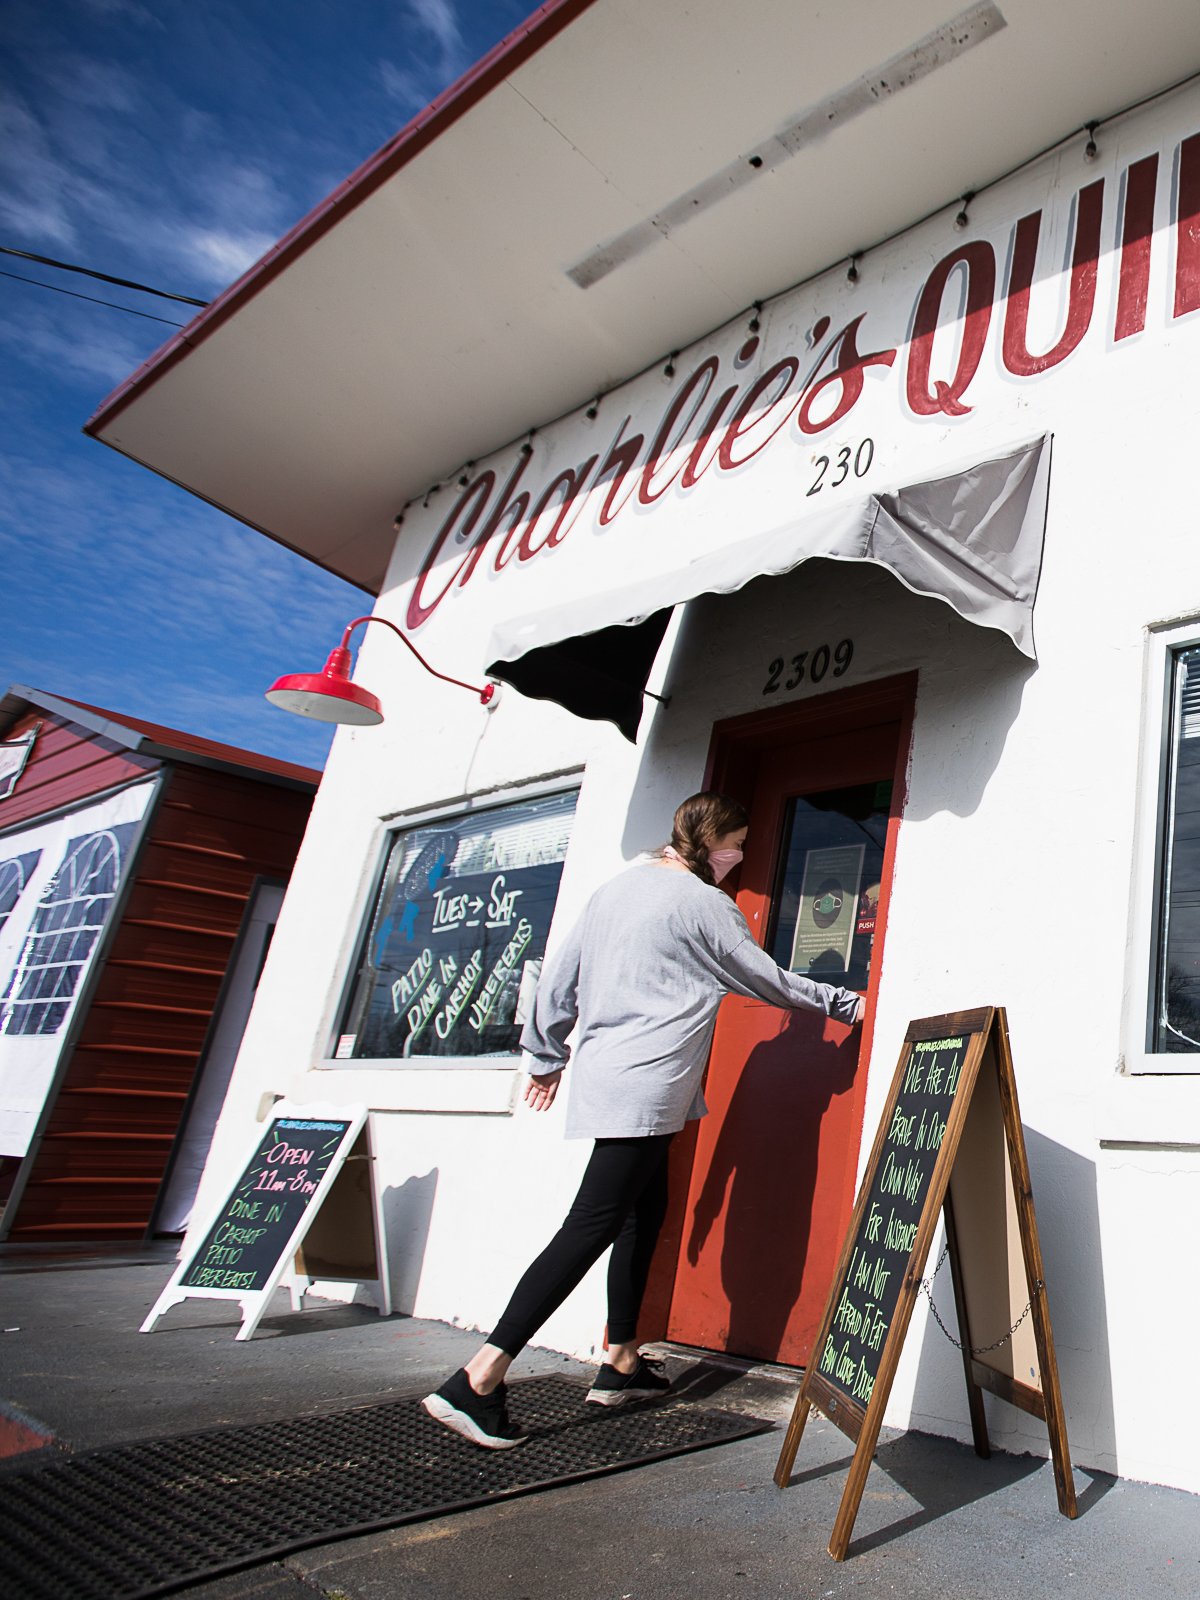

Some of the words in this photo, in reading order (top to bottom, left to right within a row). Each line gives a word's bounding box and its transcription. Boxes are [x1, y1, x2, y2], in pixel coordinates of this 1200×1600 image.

[404, 311, 897, 630] Charlie's
[806, 437, 875, 497] 230
[762, 638, 854, 696] 2309
[858, 921, 875, 929] PUSH
[392, 948, 432, 1014] PATIO
[407, 977, 442, 1034] DINE
[440, 955, 458, 985] IN
[435, 949, 482, 1039] CARHOP
[904, 1052, 925, 1094] WE
[923, 1053, 945, 1094] ARE
[888, 1105, 917, 1147] BRAVE
[914, 1108, 928, 1151] IN
[267, 1142, 315, 1165] OPEN
[228, 1198, 263, 1220] DINE
[264, 1202, 287, 1222] IN
[864, 1202, 883, 1244] FOR
[214, 1221, 267, 1244] CARHOP
[203, 1245, 243, 1265] PATIO
[847, 1247, 858, 1282] I
[853, 1251, 872, 1292] AM
[868, 1257, 891, 1301] NOT
[860, 1303, 875, 1344] TO
[867, 1308, 888, 1351] EAT
